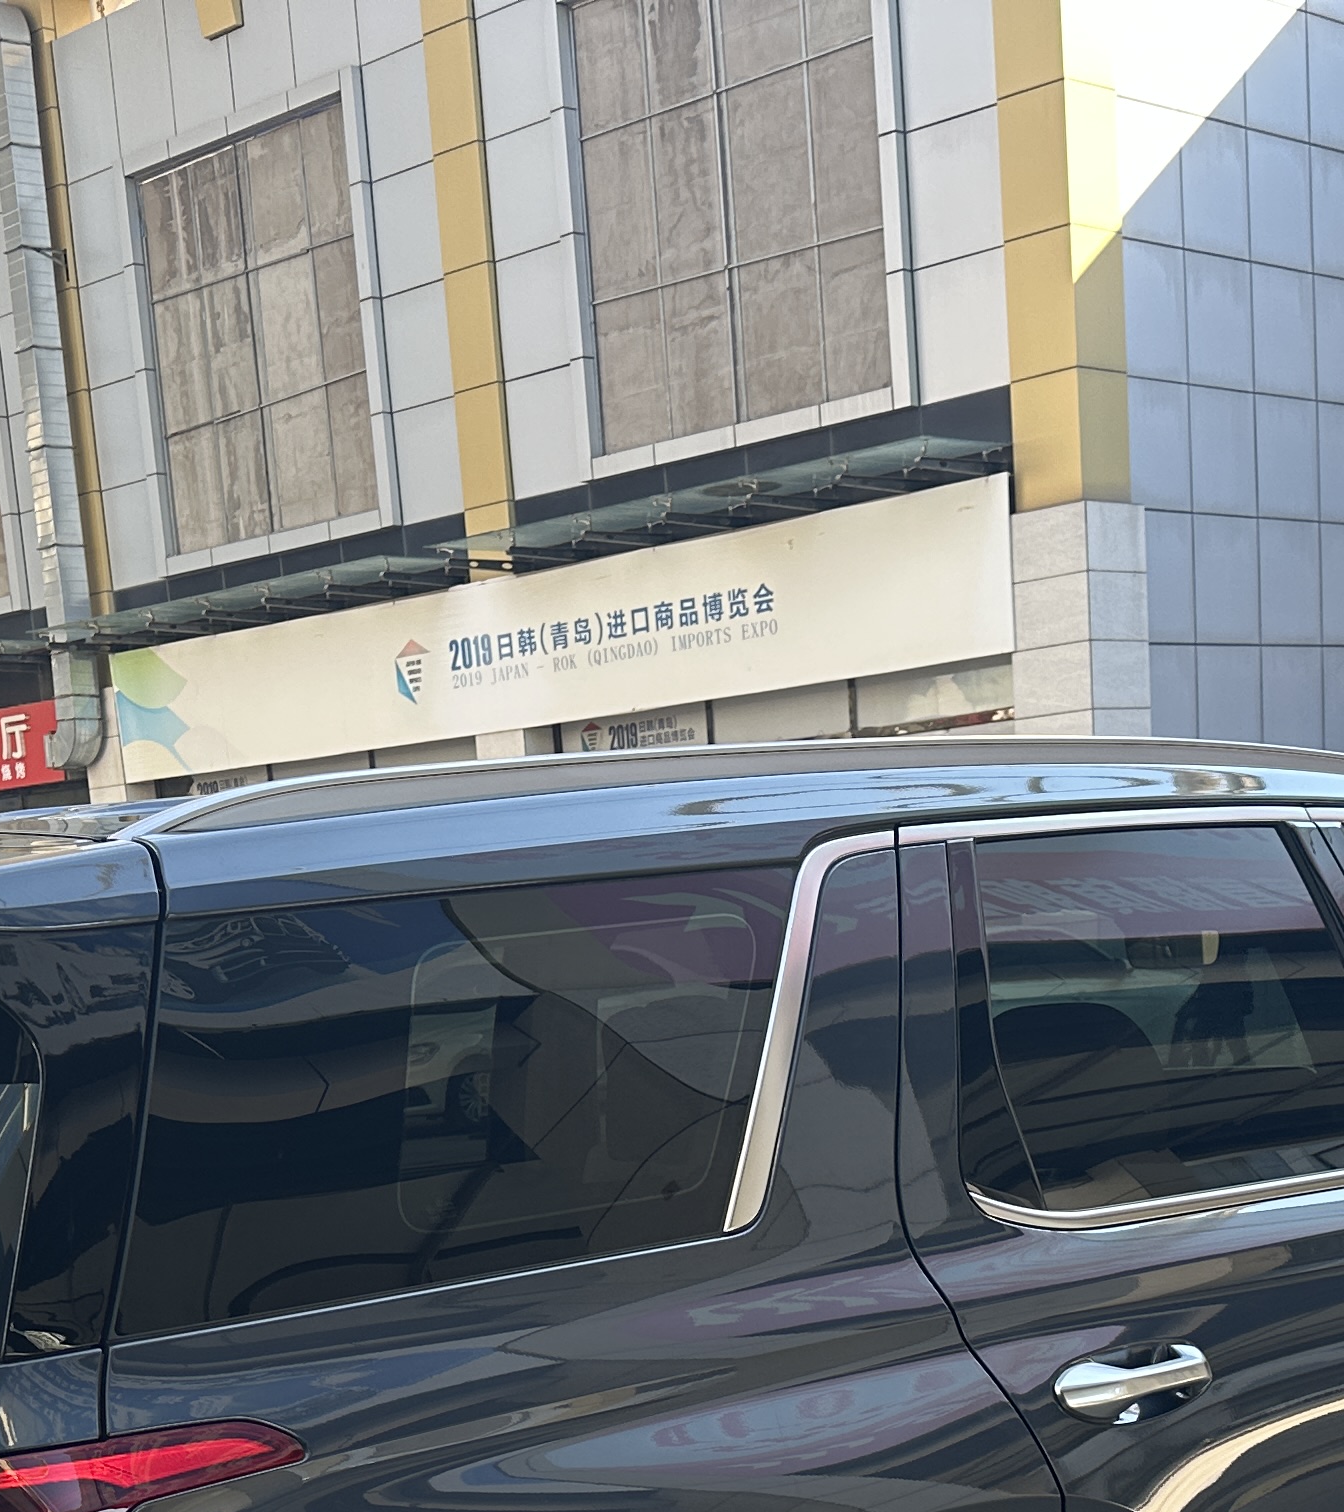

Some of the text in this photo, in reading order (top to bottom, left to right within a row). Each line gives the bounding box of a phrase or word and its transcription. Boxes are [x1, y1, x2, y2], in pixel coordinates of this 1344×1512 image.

[452, 669, 483, 690] 2019
[490, 663, 530, 686] JAPAN
[552, 653, 578, 673] ROK
[588, 637, 659, 667] (QINGDAO)
[671, 627, 732, 653] IMPORTS
[742, 618, 779, 640] EXPO
